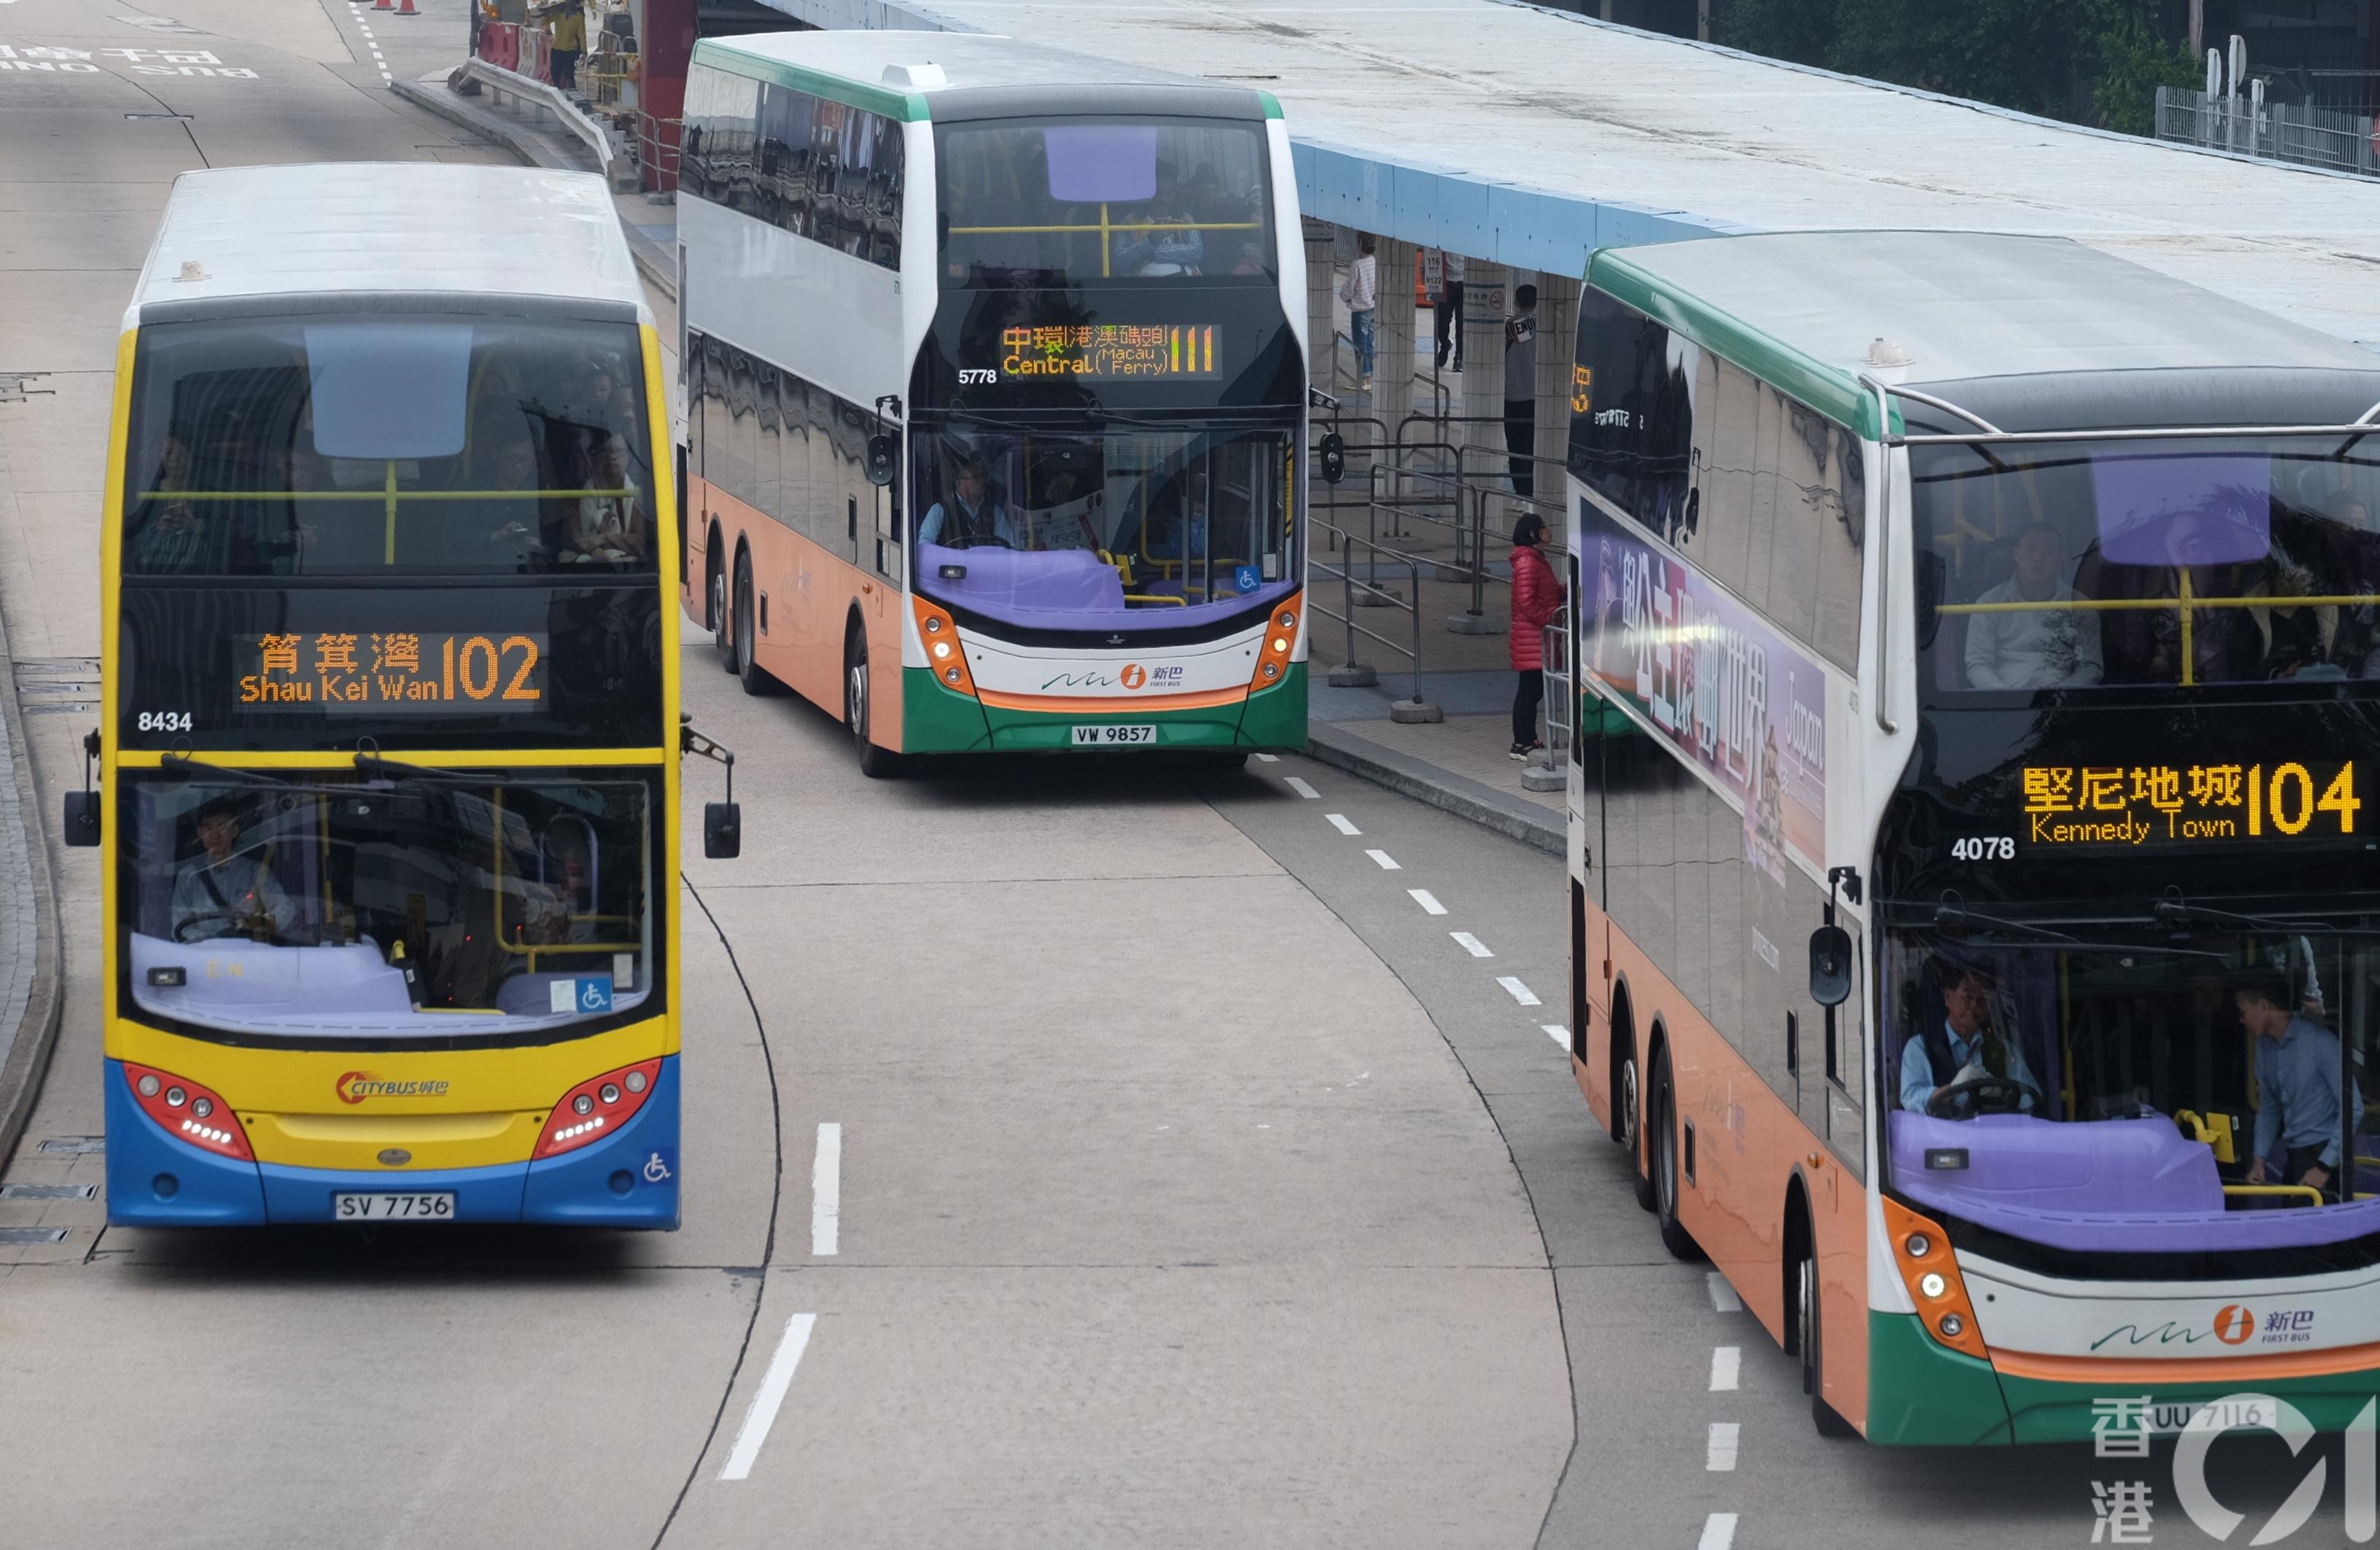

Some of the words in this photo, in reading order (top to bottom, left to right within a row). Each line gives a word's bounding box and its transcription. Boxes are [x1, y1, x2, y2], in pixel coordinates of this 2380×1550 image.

[131, 65, 260, 79] BUS
[1427, 257, 1441, 266] 116
[1426, 276, 1442, 284] N122
[1170, 325, 1212, 373] 111
[1003, 354, 1094, 375] Central
[958, 369, 998, 384] 5778
[257, 632, 419, 674] 筲箕灣
[443, 635, 541, 701] 102
[1152, 666, 1183, 679] 新巴
[239, 675, 312, 702] Shau
[321, 675, 368, 702] Kei
[378, 675, 438, 702] Wan
[138, 712, 193, 732] 8434
[1786, 671, 1824, 776] Japan
[1077, 728, 1099, 742] VW
[1106, 727, 1152, 741] 9857
[2023, 763, 2242, 813] 堅尼地城
[2248, 760, 2361, 836] 104
[2031, 811, 2150, 845] Kennedy
[2161, 809, 2236, 838] Town
[1951, 836, 2015, 861] 4078
[351, 1080, 419, 1095] CITYBUS
[419, 1080, 449, 1094] 城巴
[342, 1197, 372, 1216] SV
[384, 1196, 449, 1216] 7756
[2264, 1310, 2314, 1332] 新巴
[2262, 1333, 2288, 1344] FIRST
[2290, 1333, 2311, 1341] BUS
[2155, 1406, 2190, 1429] UU
[2204, 1403, 2262, 1428] 7116
